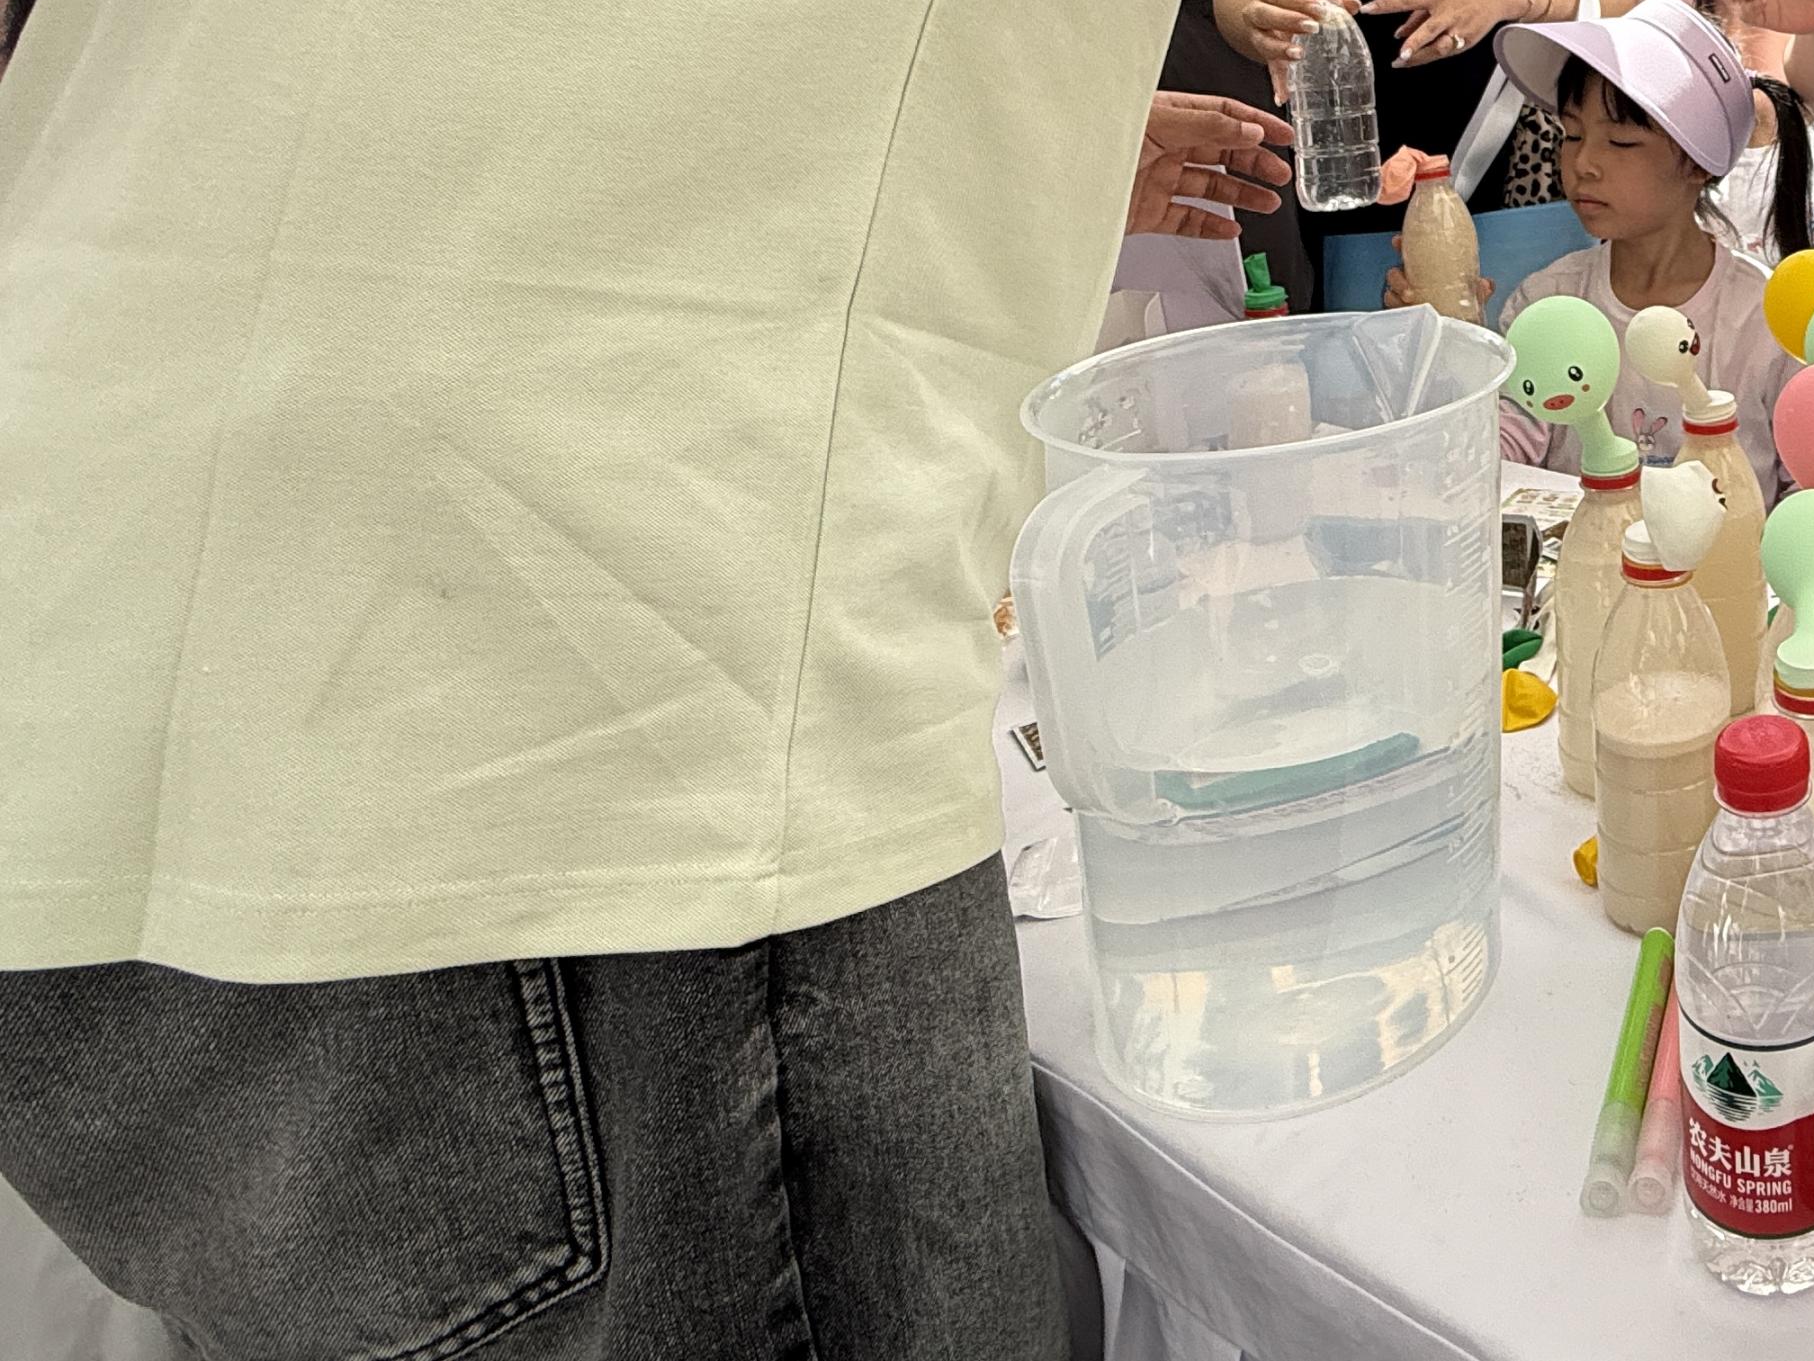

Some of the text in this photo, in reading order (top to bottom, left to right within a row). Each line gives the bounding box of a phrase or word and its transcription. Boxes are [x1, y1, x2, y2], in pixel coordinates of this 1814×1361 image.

[1689, 1117, 1793, 1178] 农夫山泉
[1690, 1147, 1793, 1196] NONGFU SPRING
